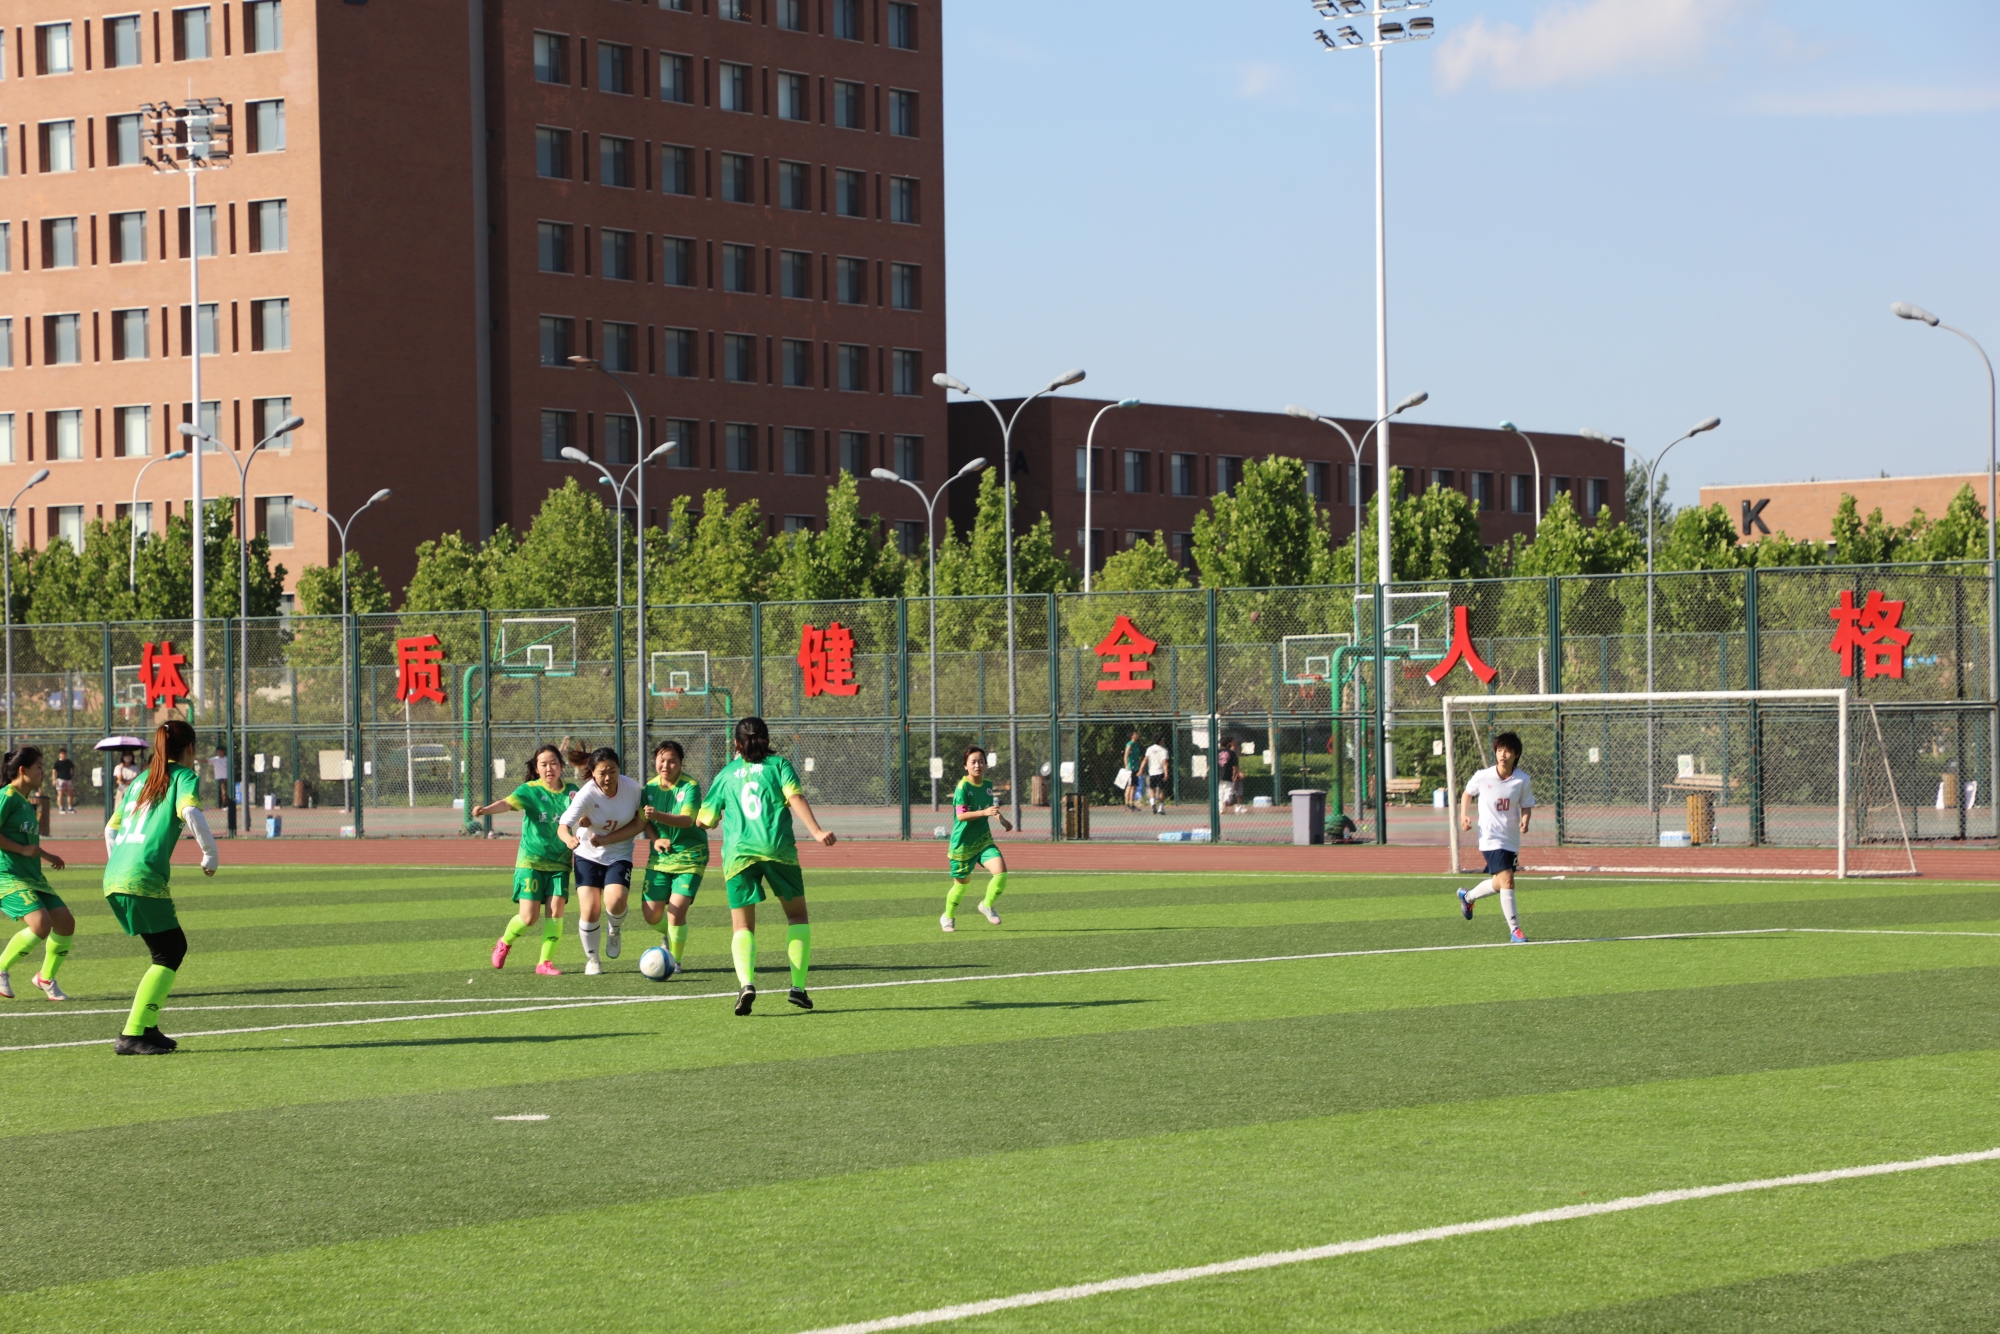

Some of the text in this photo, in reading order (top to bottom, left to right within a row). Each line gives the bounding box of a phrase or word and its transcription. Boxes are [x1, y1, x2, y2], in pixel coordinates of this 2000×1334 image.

[1742, 498, 1771, 535] K
[137, 589, 1913, 709] 体 质 健 全 人 格
[741, 781, 762, 820] 6
[1496, 798, 1510, 811] 20
[115, 799, 151, 845] 31
[602, 819, 618, 831] 21
[18, 890, 39, 906] 16
[524, 877, 538, 893] 10
